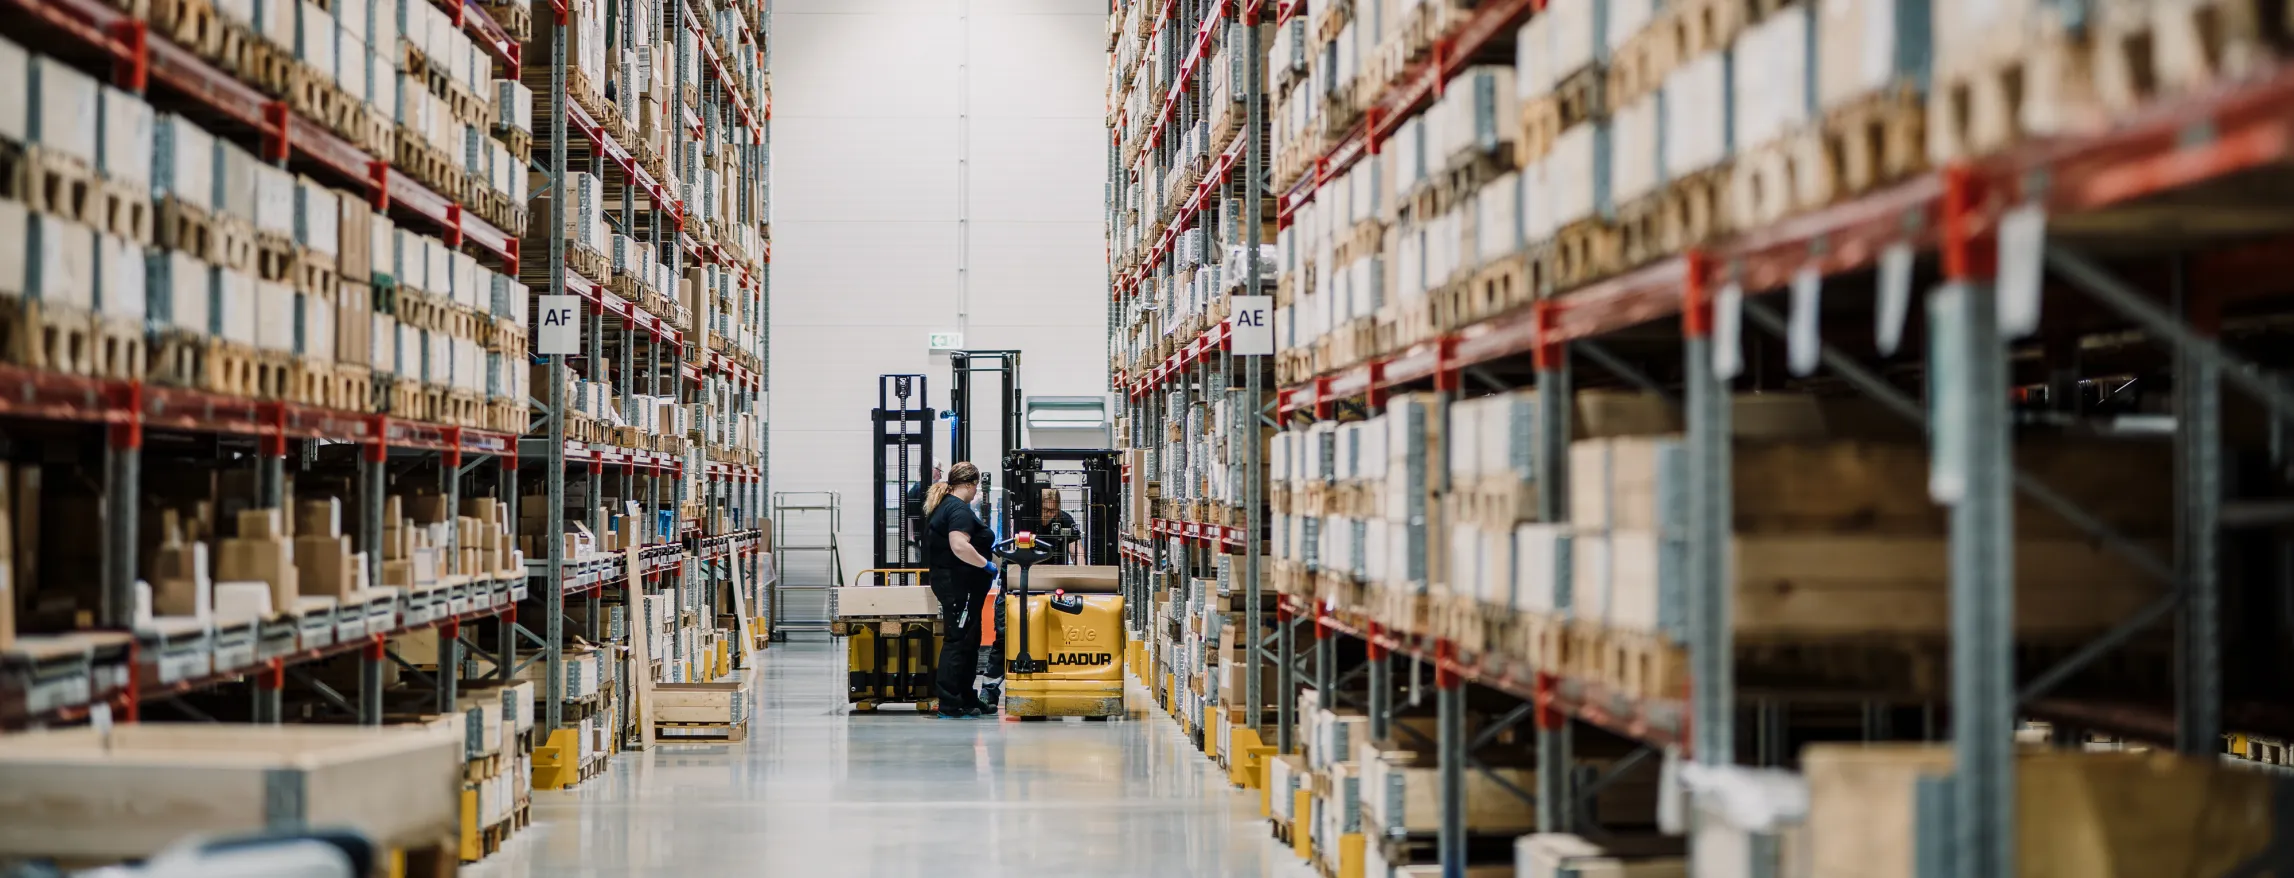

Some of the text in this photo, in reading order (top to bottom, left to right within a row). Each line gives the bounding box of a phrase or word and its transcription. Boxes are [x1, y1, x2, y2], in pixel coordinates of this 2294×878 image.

[544, 309, 571, 326] AF
[1237, 310, 1264, 327] AE
[1061, 625, 1096, 641] Yale
[1048, 653, 1111, 665] LAADUR
